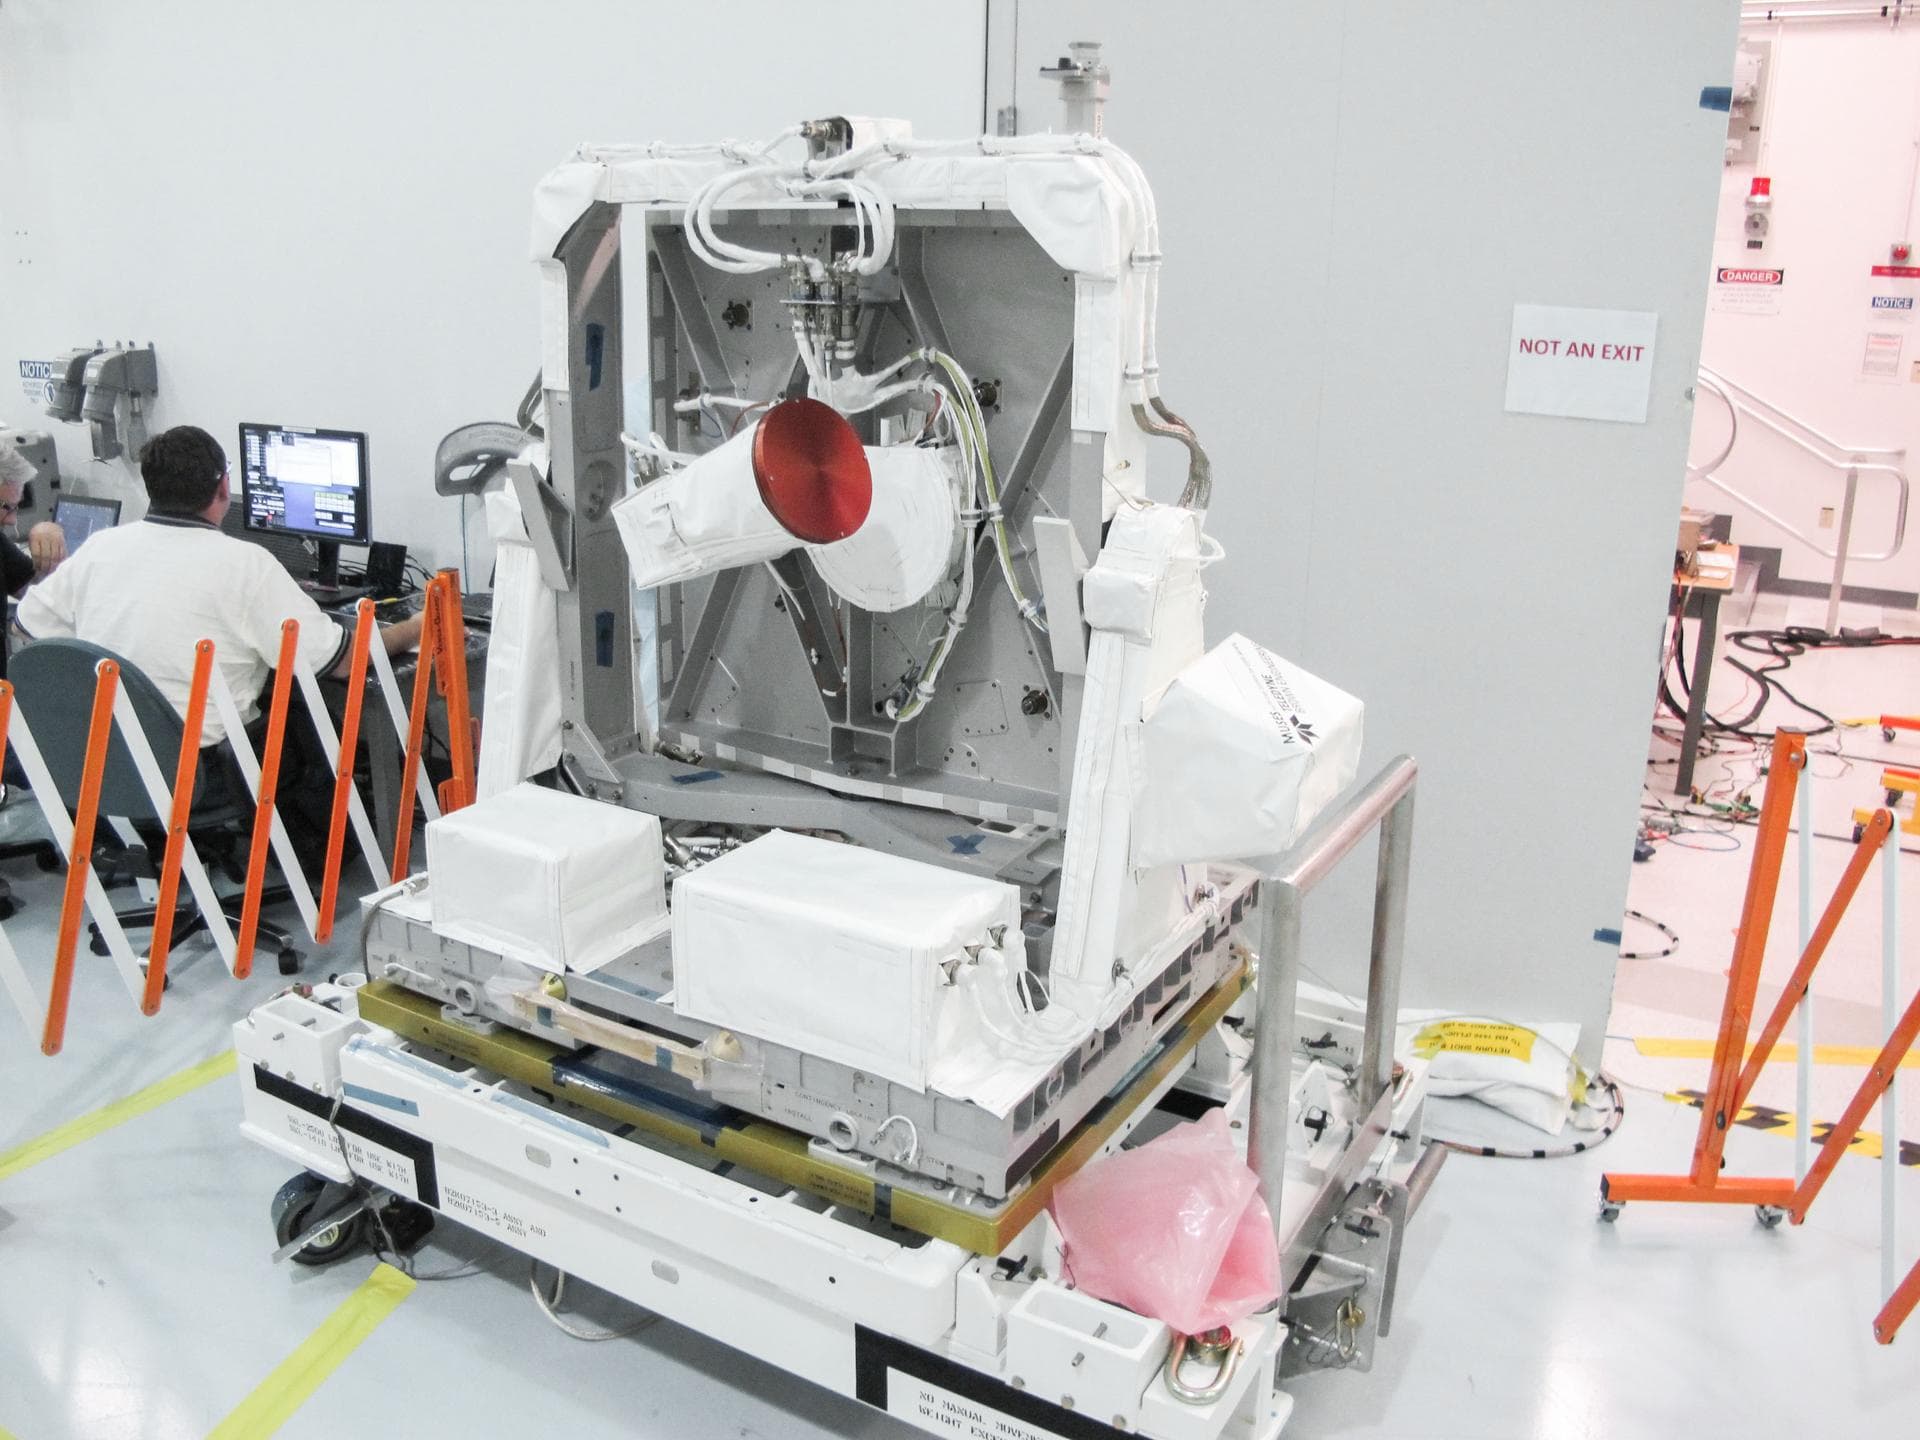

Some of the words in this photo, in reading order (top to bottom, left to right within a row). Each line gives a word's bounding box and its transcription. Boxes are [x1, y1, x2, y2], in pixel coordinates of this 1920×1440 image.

[1727, 272, 1773, 283] DANGER
[1874, 297, 1912, 309] NOTICE
[1519, 338, 1561, 356] NOT
[1566, 341, 1595, 359] AN
[1601, 344, 1645, 362] EXIT
[21, 362, 52, 378] NOTIC
[1261, 674, 1291, 712] TELEDYNE
[919, 1391, 934, 1404] NO
[942, 1400, 986, 1425] MANUAL
[919, 1404, 962, 1429] WEIGHT
